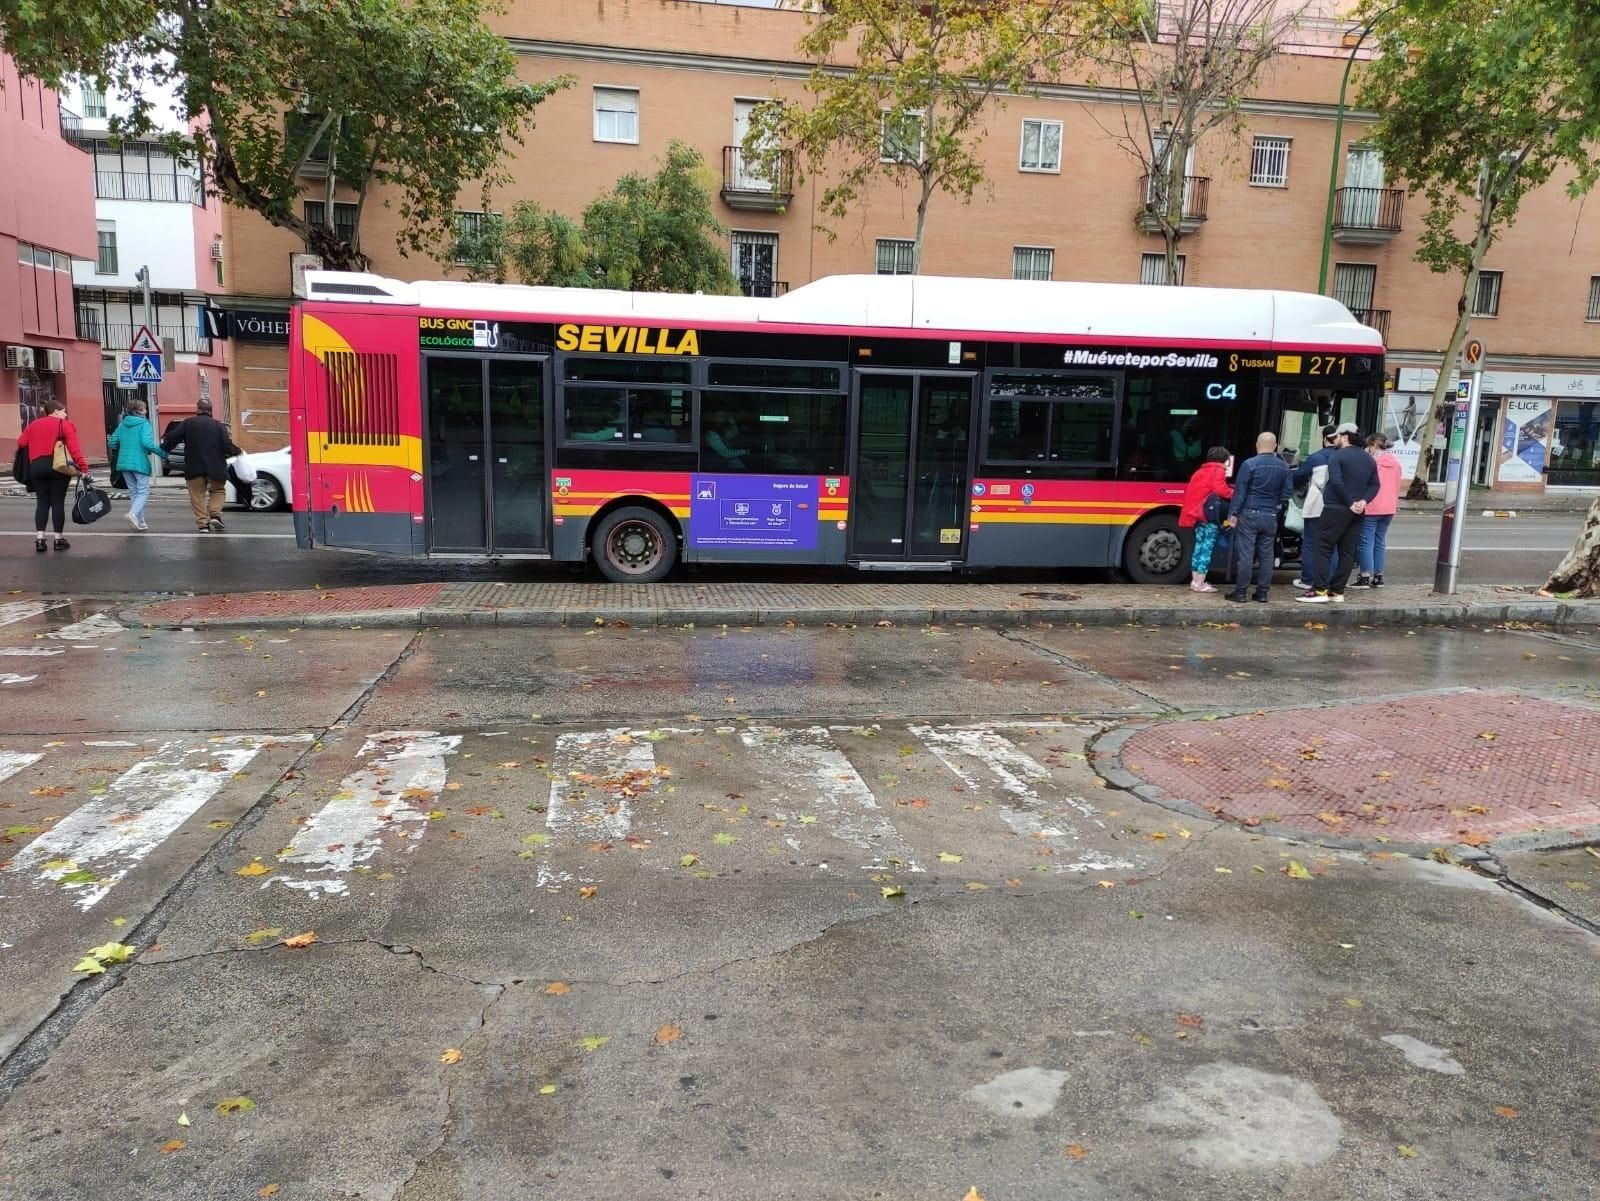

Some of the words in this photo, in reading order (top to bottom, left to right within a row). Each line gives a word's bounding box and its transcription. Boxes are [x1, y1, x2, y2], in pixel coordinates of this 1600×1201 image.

[419, 317, 444, 329] BUS
[446, 319, 474, 331] GNC
[420, 335, 474, 347] ECOLÓGICO
[556, 324, 699, 356] SEVILLA
[1063, 350, 1218, 368] #MuéveteporSevilla
[1241, 358, 1274, 368] TUSSAM
[1309, 356, 1347, 375] 271
[1206, 383, 1237, 400] C4
